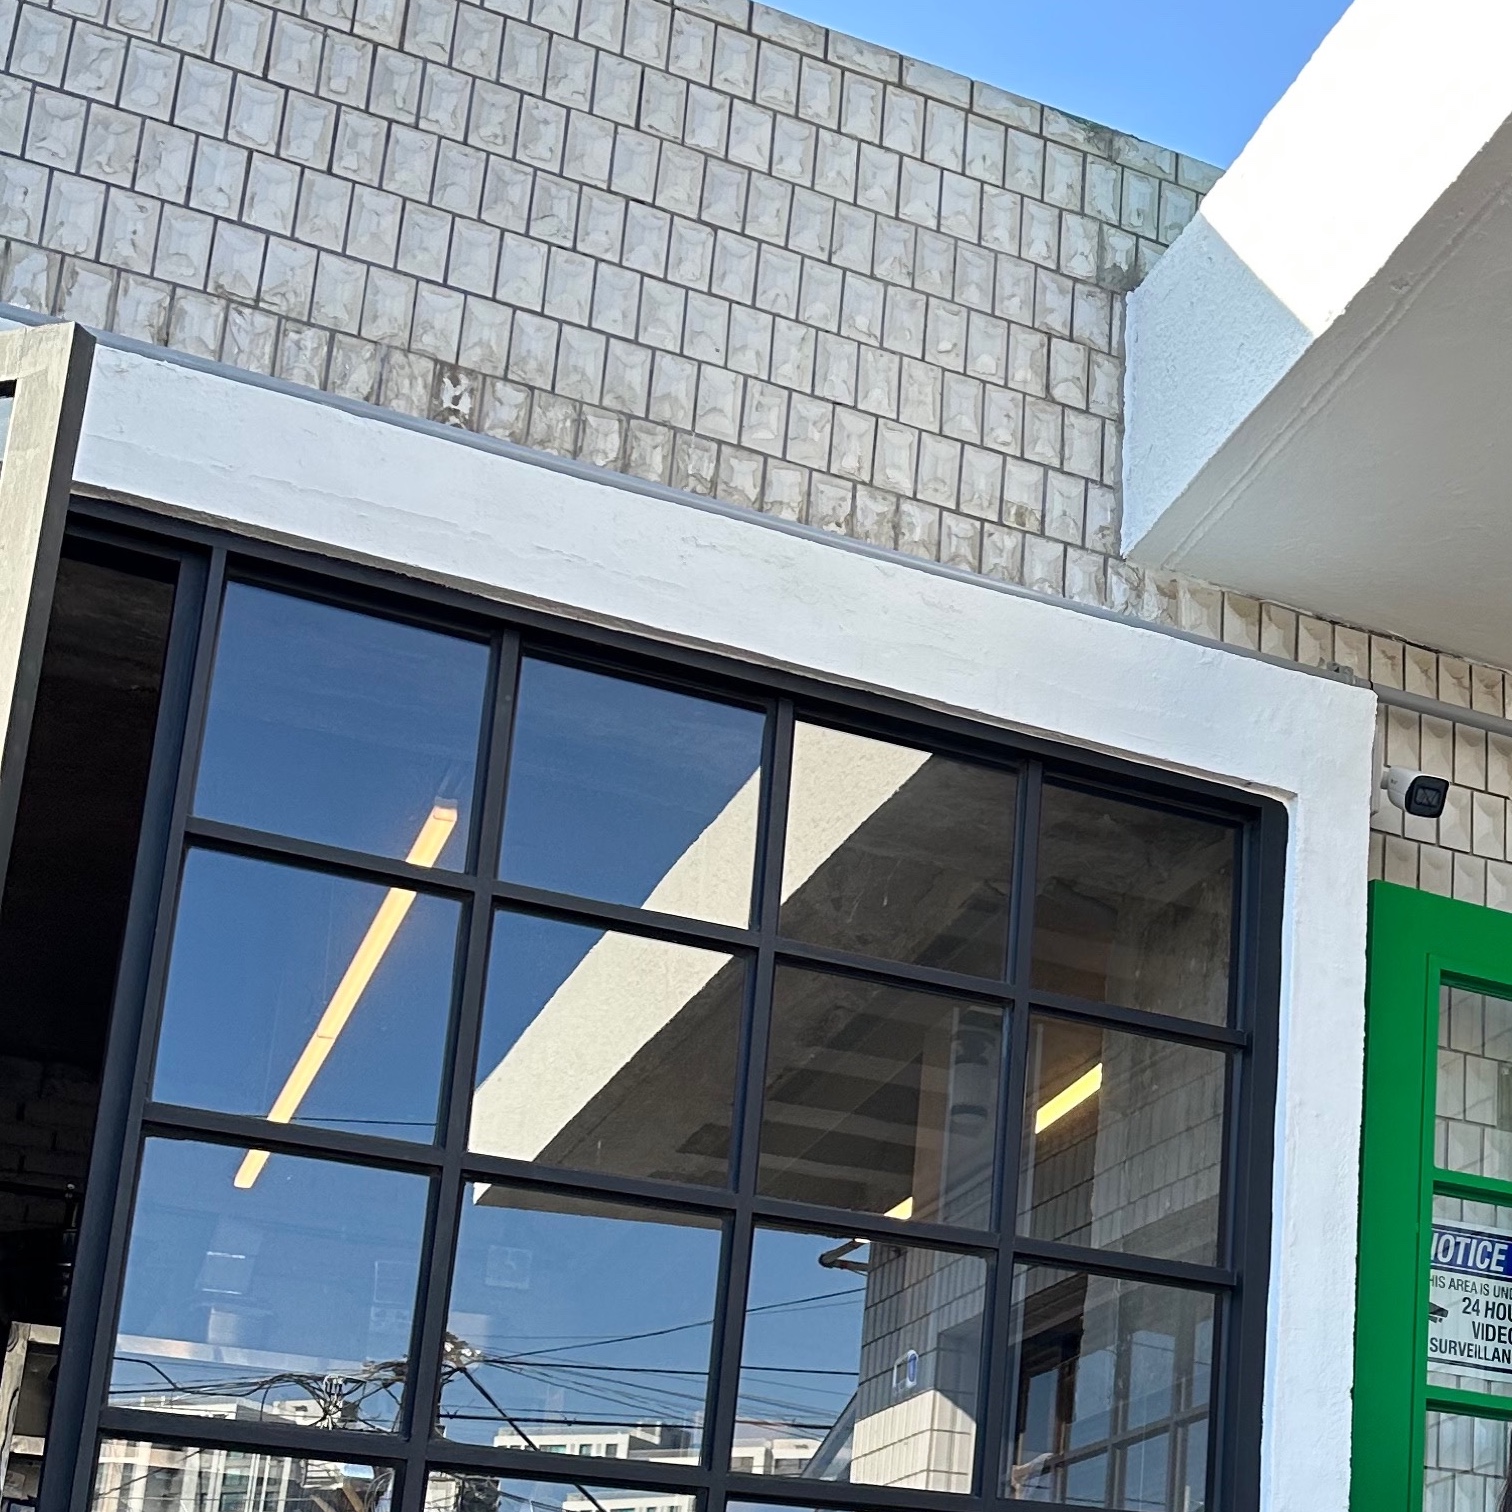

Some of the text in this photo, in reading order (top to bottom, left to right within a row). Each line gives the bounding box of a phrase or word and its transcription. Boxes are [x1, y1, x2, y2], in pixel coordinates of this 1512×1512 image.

[1447, 1277, 1478, 1295] AREA
[1480, 1282, 1490, 1297] IS
[1462, 1296, 1481, 1317] 24
